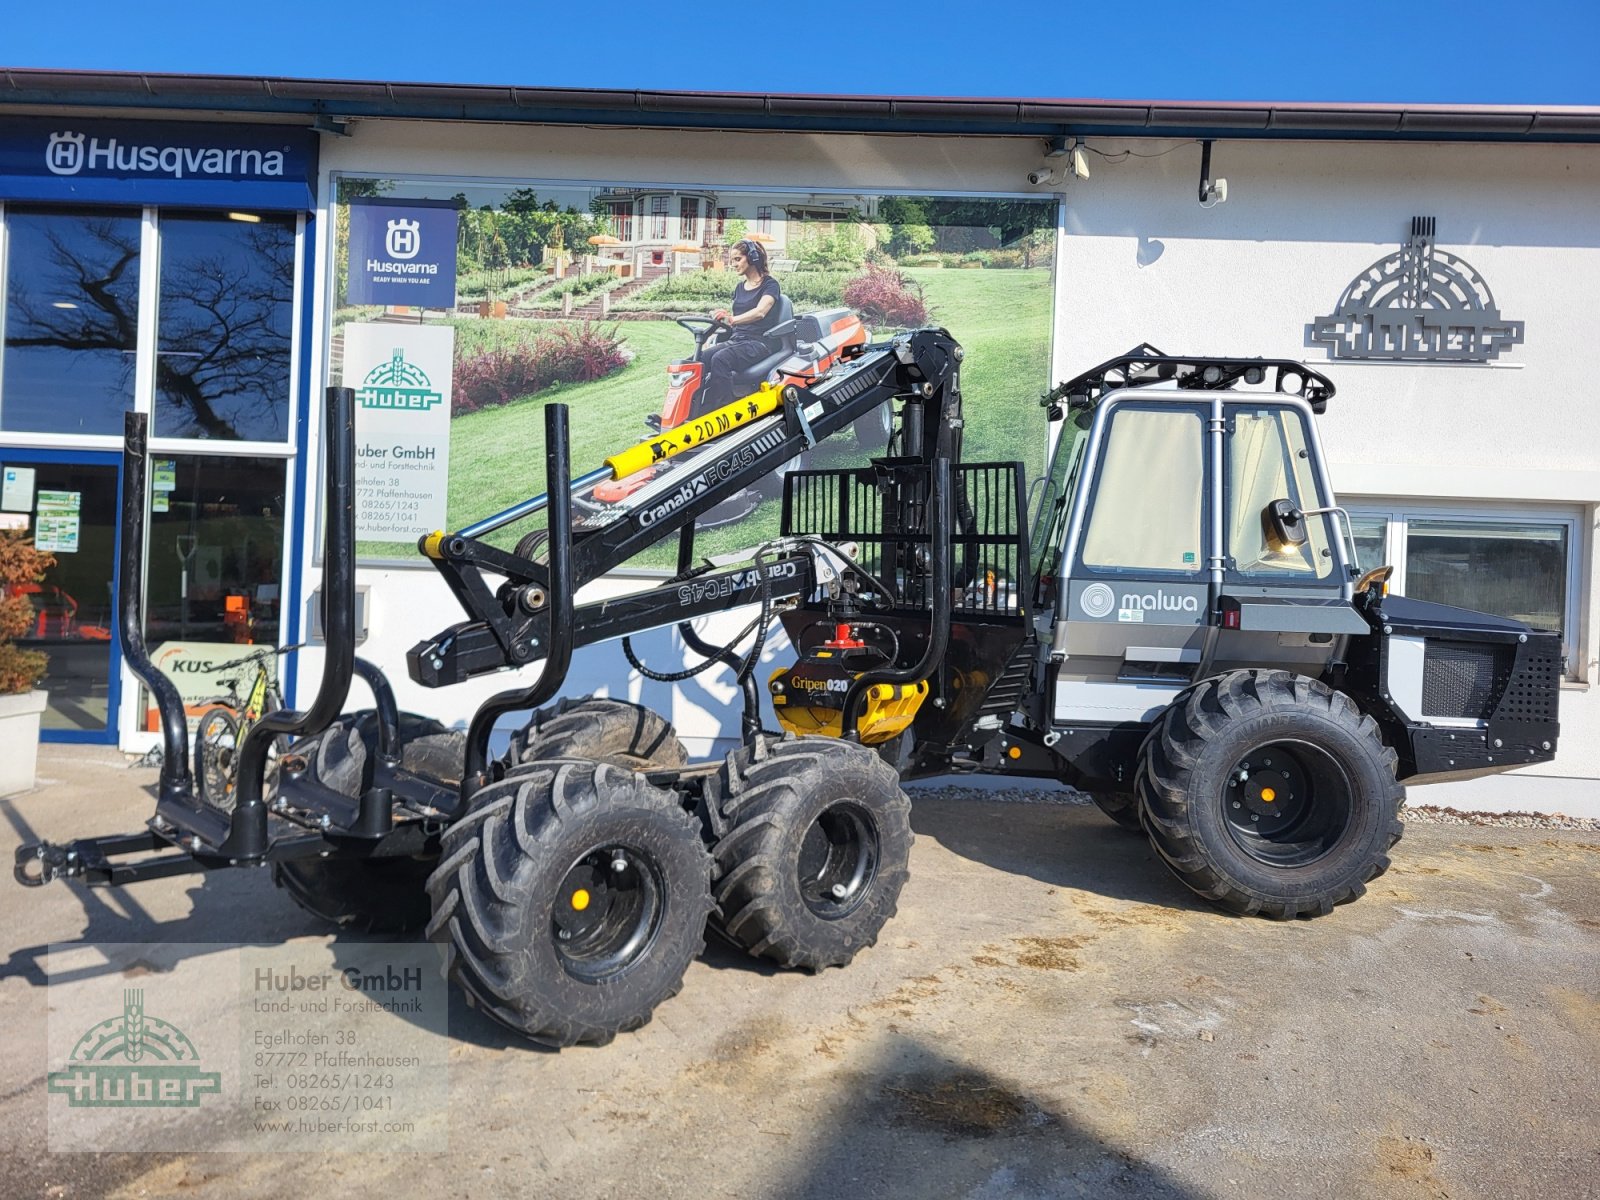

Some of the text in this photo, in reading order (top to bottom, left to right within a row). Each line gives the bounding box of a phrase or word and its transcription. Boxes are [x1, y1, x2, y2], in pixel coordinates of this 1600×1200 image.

[88, 138, 284, 178] Husqvarna
[366, 259, 438, 275] Husqvarna
[358, 388, 440, 409] Huber
[695, 420, 715, 442] 20
[355, 443, 435, 460] uber GmbH
[355, 460, 435, 471] nd- und Forsttechnik
[355, 477, 400, 487] elhofen 38
[639, 447, 755, 527] Cranab FC45
[357, 488, 433, 499] 772 Pfaffenhausen
[361, 500, 419, 510] 08265/1243
[361, 511, 418, 522] 08265/1041
[355, 522, 429, 533] w.huber-forst.com
[678, 576, 733, 606] FC45
[1121, 589, 1198, 611] malwa
